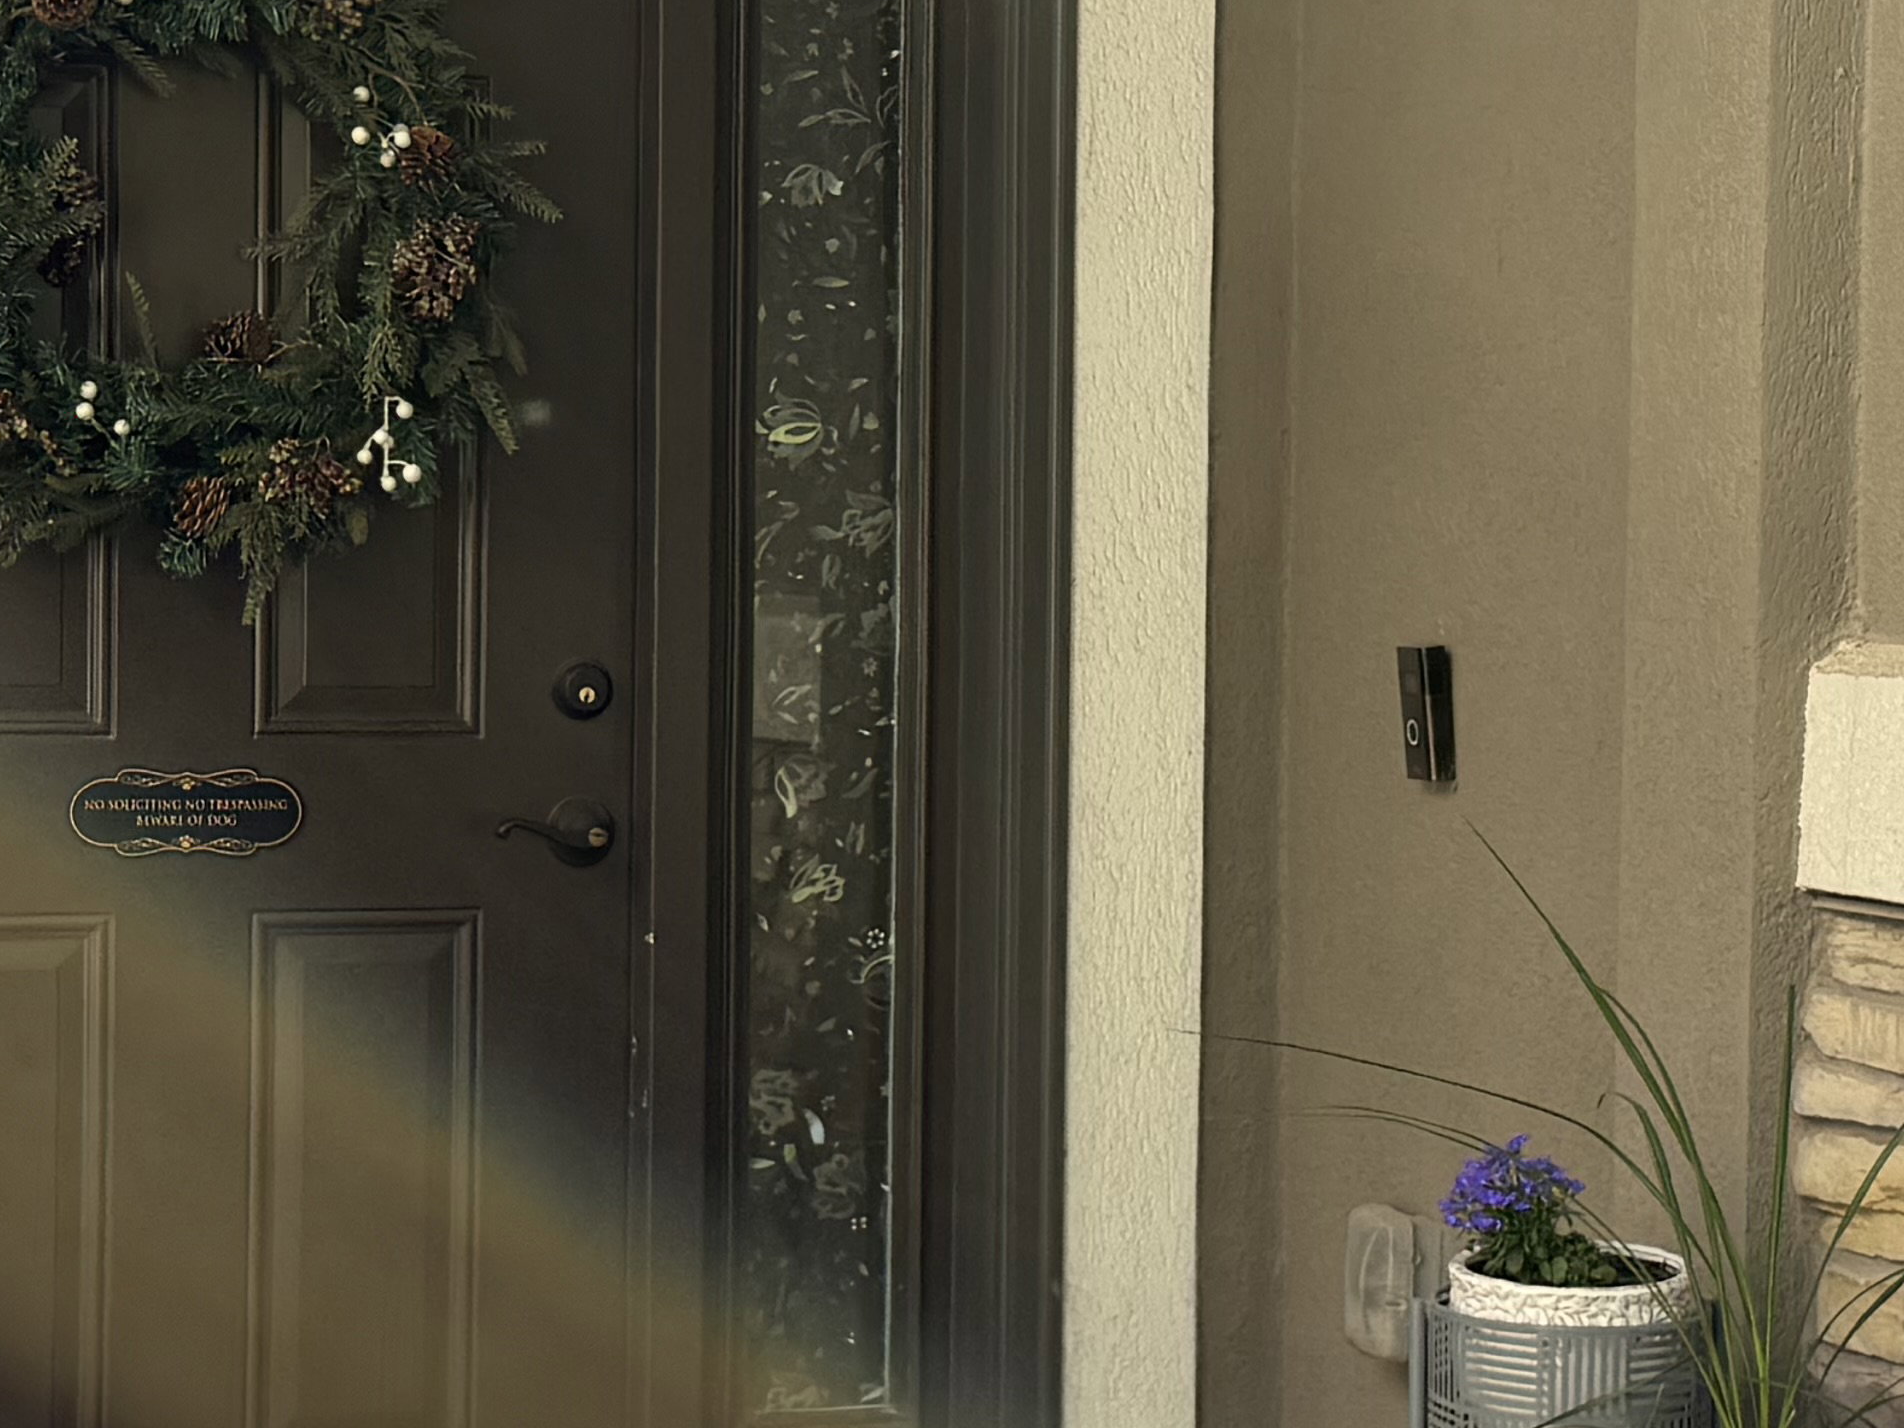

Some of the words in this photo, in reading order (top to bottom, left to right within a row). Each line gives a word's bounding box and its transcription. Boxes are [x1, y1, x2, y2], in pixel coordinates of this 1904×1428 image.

[84, 799, 105, 811] NO
[108, 799, 181, 811] SOLICITING
[185, 799, 205, 811] NO
[209, 798, 288, 811] TRESPASSING
[136, 814, 183, 827] BEWARE
[187, 814, 203, 827] OF
[207, 814, 237, 827] DOG
